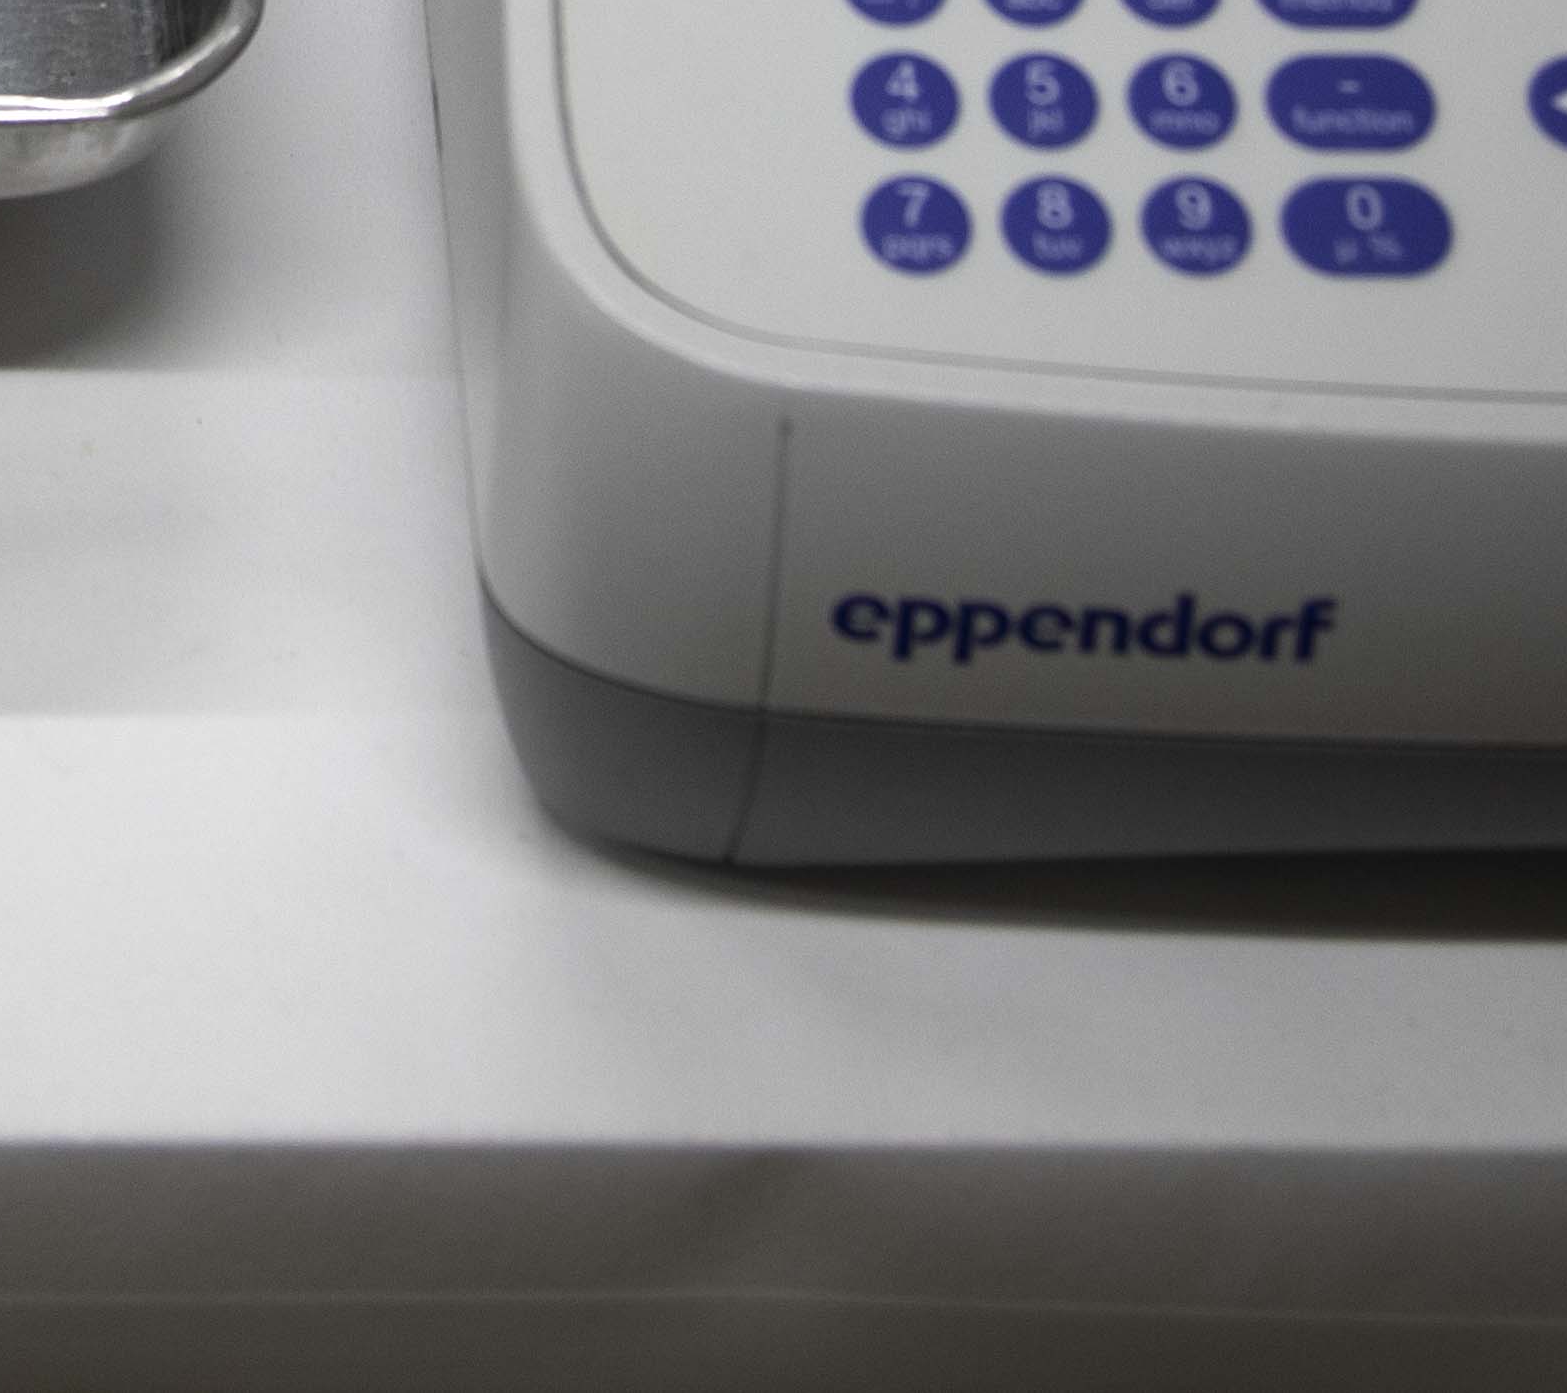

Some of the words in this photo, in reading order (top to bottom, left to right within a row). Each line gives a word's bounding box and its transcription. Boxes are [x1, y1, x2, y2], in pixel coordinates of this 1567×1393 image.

[884, 59, 920, 101] 4
[1024, 61, 1061, 106] 5
[1160, 60, 1200, 107] 6
[1290, 104, 1414, 134] function
[897, 181, 930, 228] 7
[1035, 181, 1074, 230] 8
[1174, 182, 1213, 230] 9
[1346, 183, 1384, 231] 0
[830, 590, 1340, 666] eppendorf
